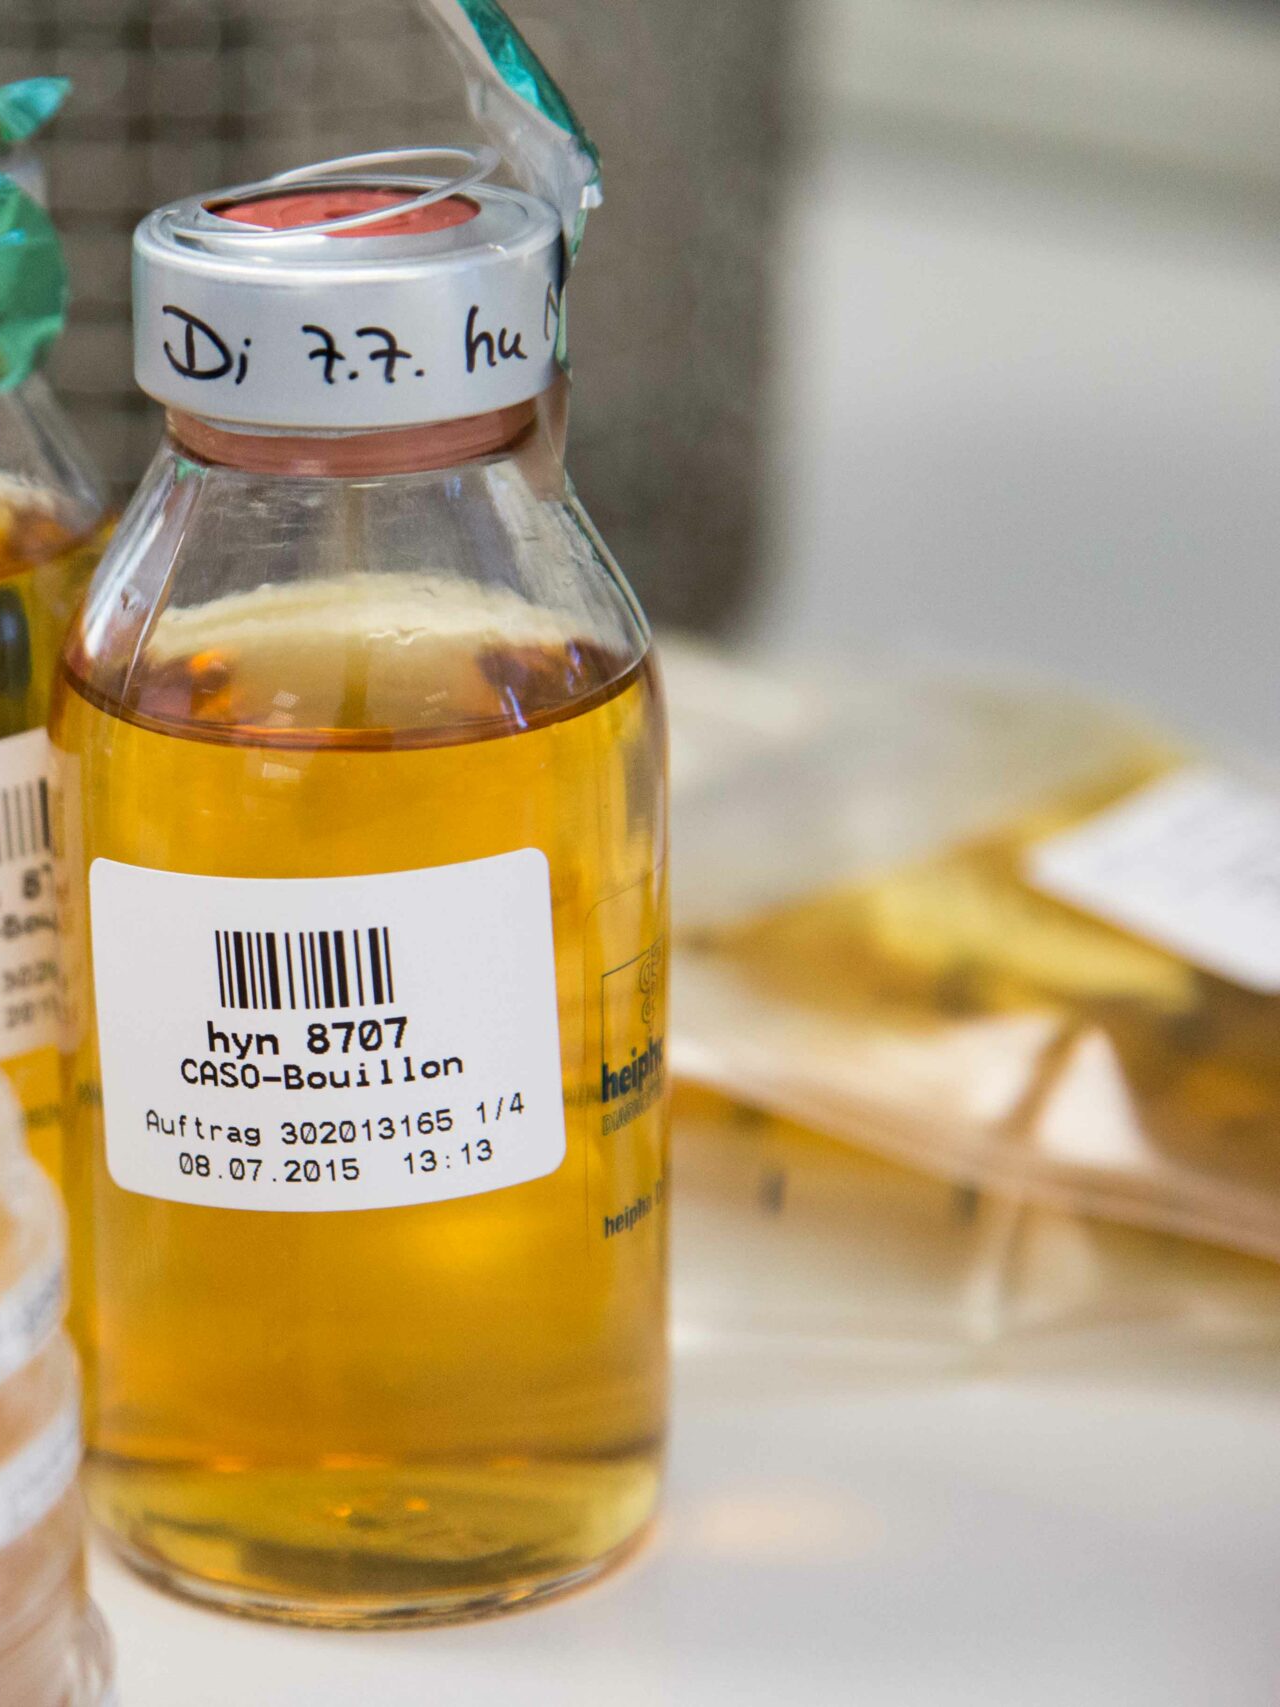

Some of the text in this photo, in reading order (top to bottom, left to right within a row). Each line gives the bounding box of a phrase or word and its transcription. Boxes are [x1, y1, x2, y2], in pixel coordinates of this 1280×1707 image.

[162, 304, 252, 385] Di
[301, 324, 425, 385] 7.7.
[206, 1016, 408, 1060] hyn 8707
[179, 1055, 464, 1091] CASO-Bouillon
[145, 1091, 526, 1147] Auftrag 302013165 1/4
[178, 1138, 494, 1184] 08.07.2015 13:13
